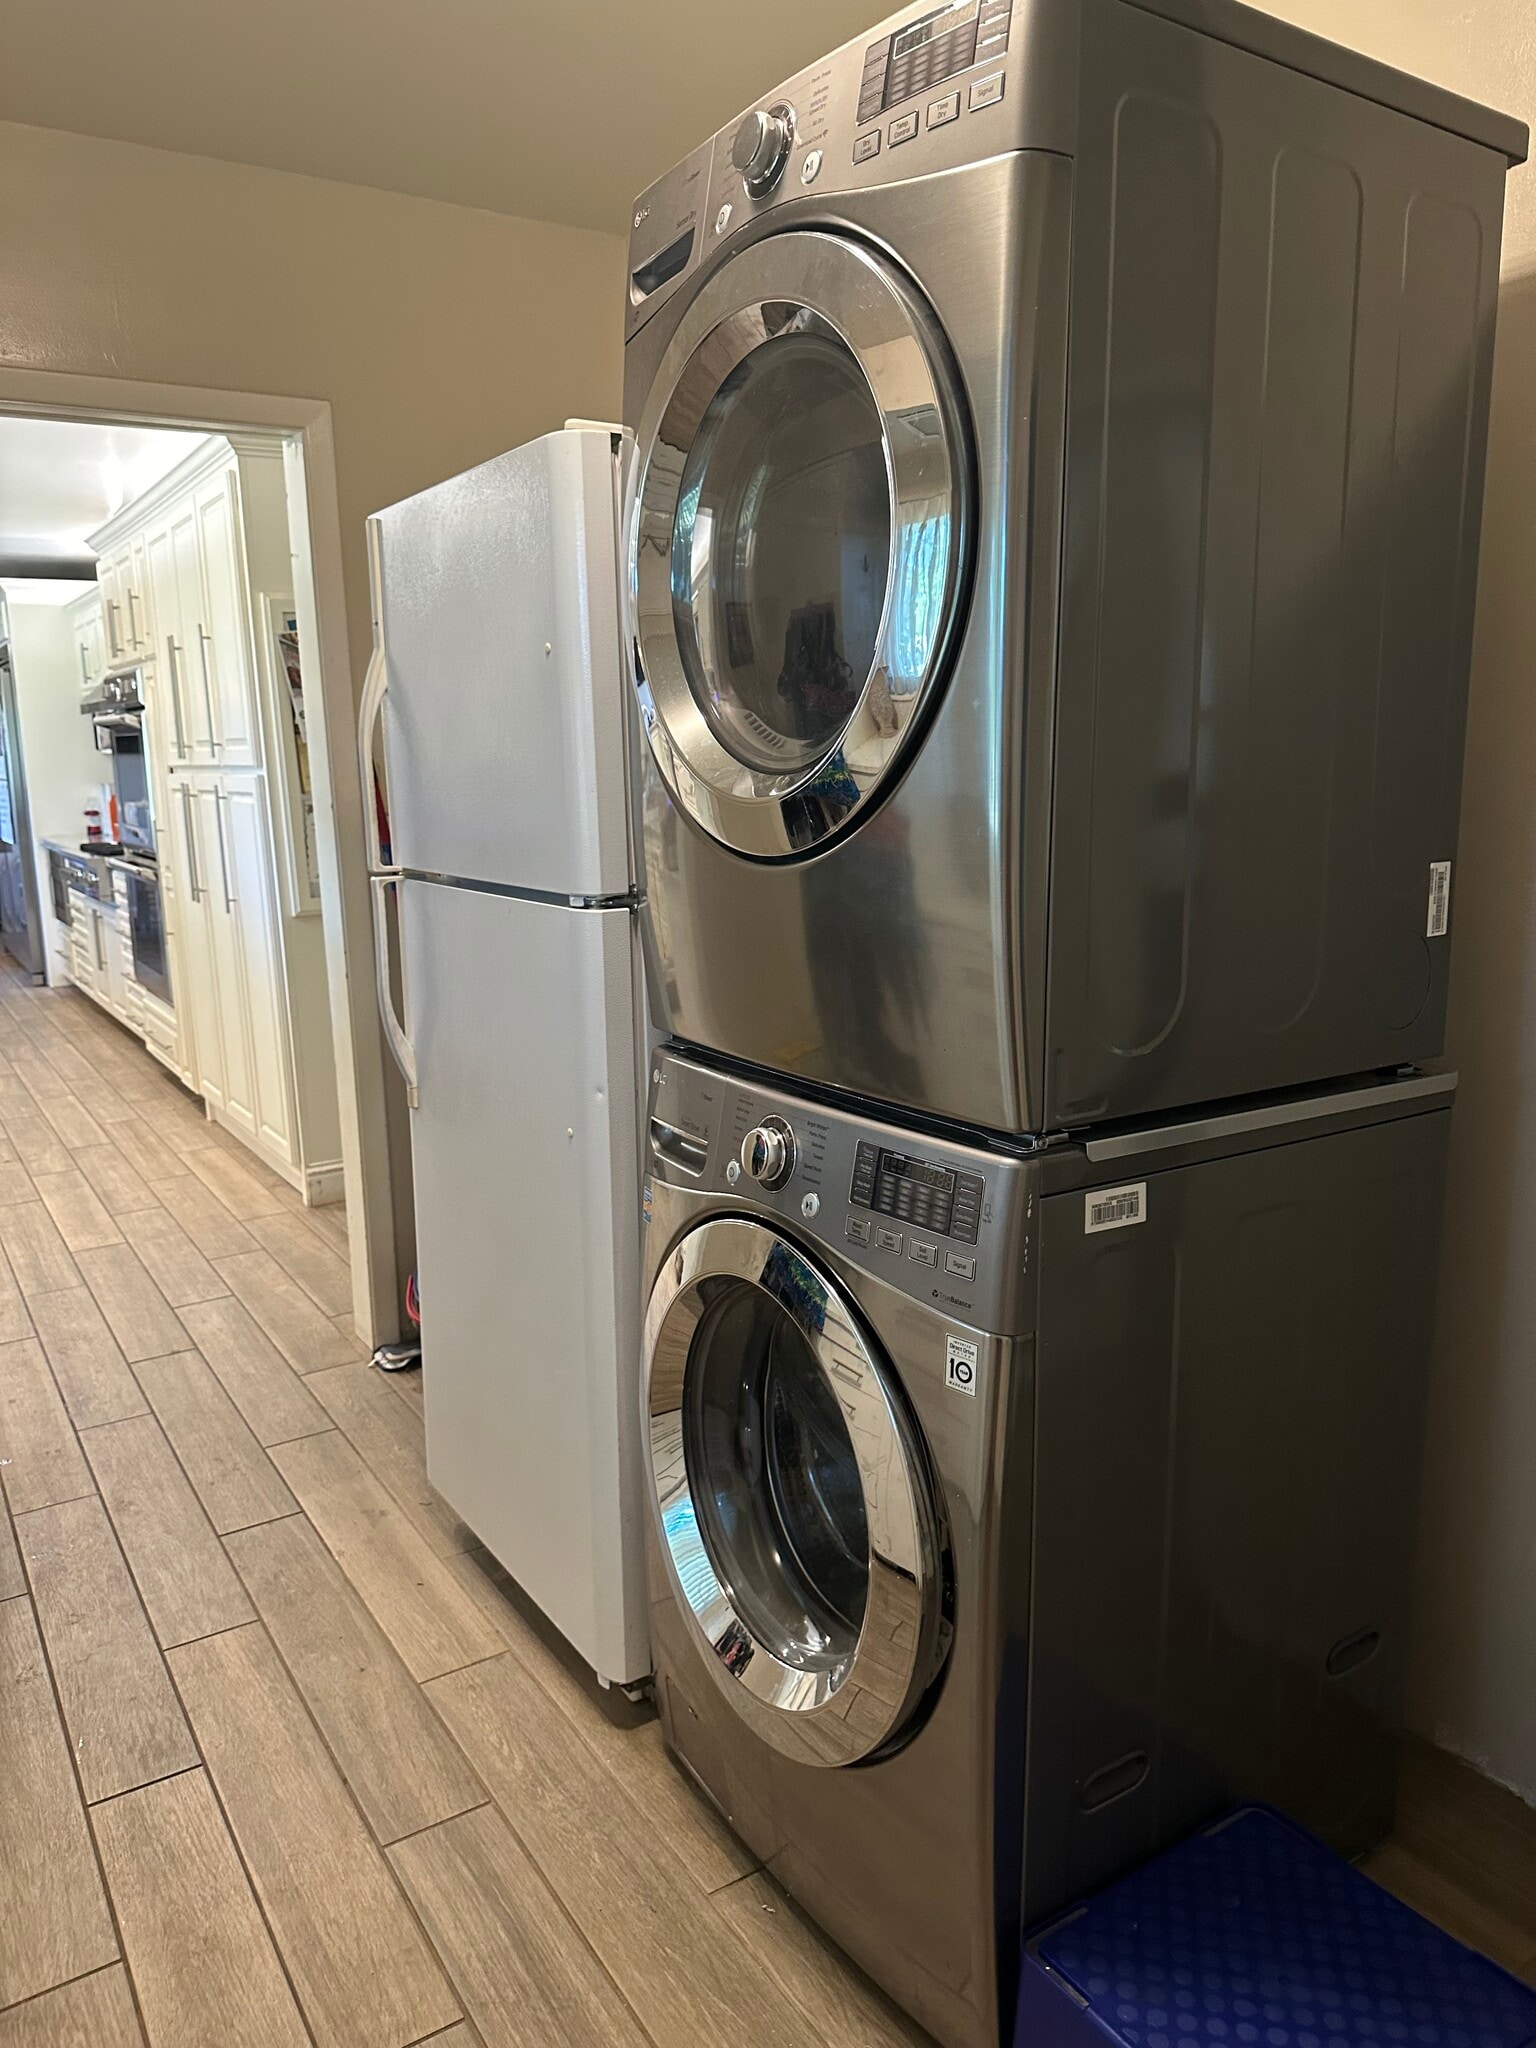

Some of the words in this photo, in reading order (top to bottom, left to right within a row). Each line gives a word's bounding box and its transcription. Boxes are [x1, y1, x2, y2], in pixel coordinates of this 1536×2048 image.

[977, 85, 994, 98] Signal
[936, 102, 949, 111] Time
[937, 110, 946, 119] Dry
[894, 127, 911, 138] Control
[916, 1252, 928, 1260] Level
[952, 1260, 967, 1271] Signal
[949, 1342, 963, 1353] Direct
[963, 1347, 975, 1357] Drive
[949, 1357, 973, 1384] 10
[948, 1380, 973, 1392] WARRANTY
